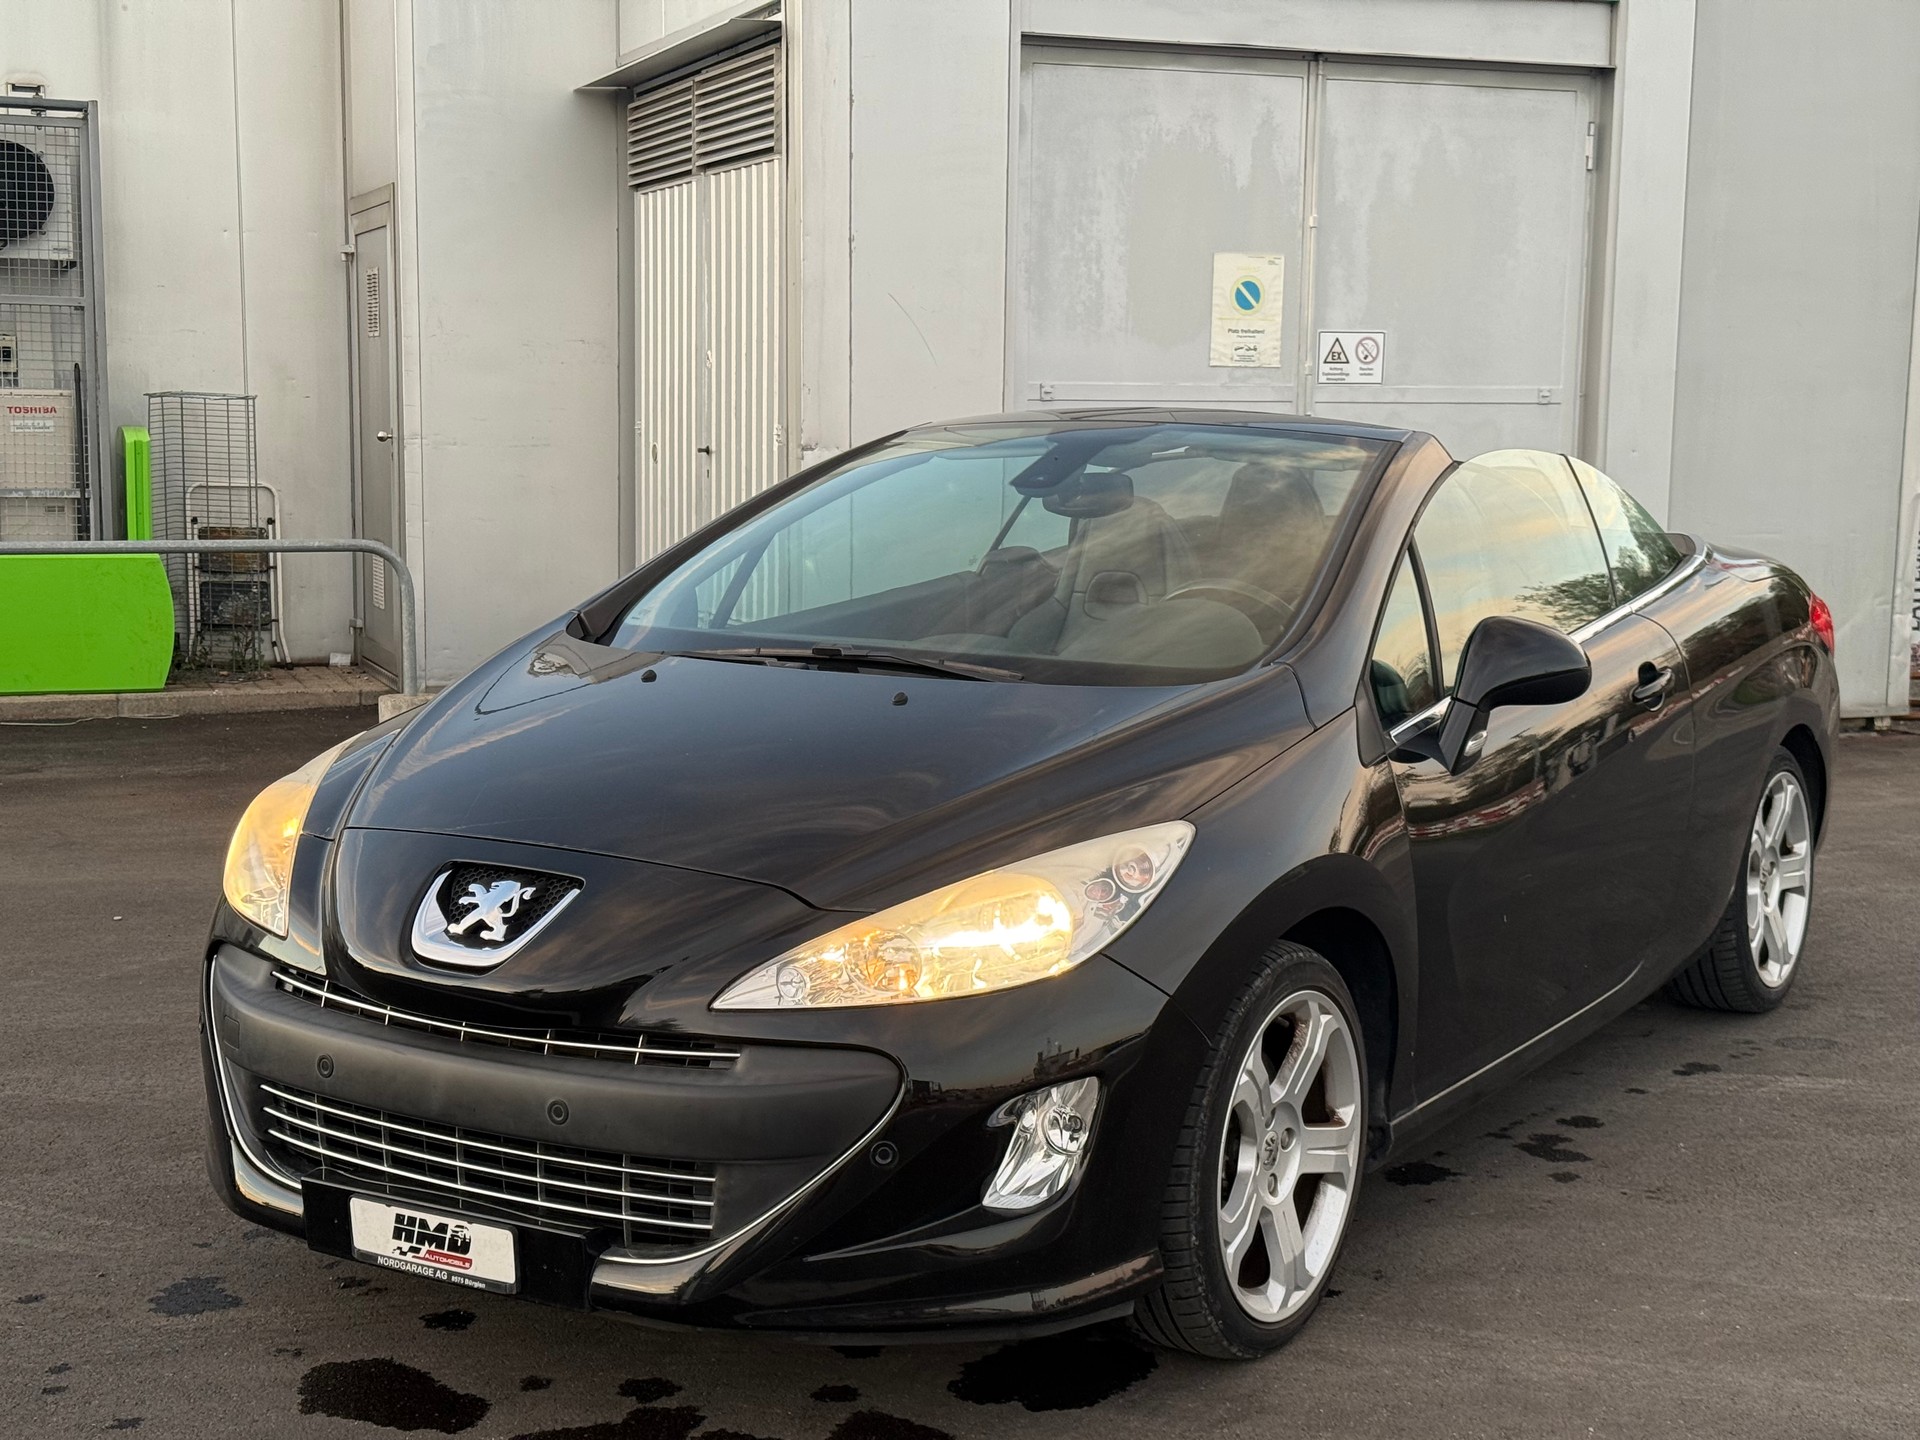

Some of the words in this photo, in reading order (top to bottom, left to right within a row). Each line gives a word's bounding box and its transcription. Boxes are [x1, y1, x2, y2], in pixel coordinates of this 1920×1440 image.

[1331, 351, 1342, 361] EX
[6, 406, 57, 414] TOSHIBA
[424, 1253, 471, 1269] AUTOMOBILE
[377, 1256, 434, 1278] NORDGARAGE
[435, 1271, 448, 1280] AG
